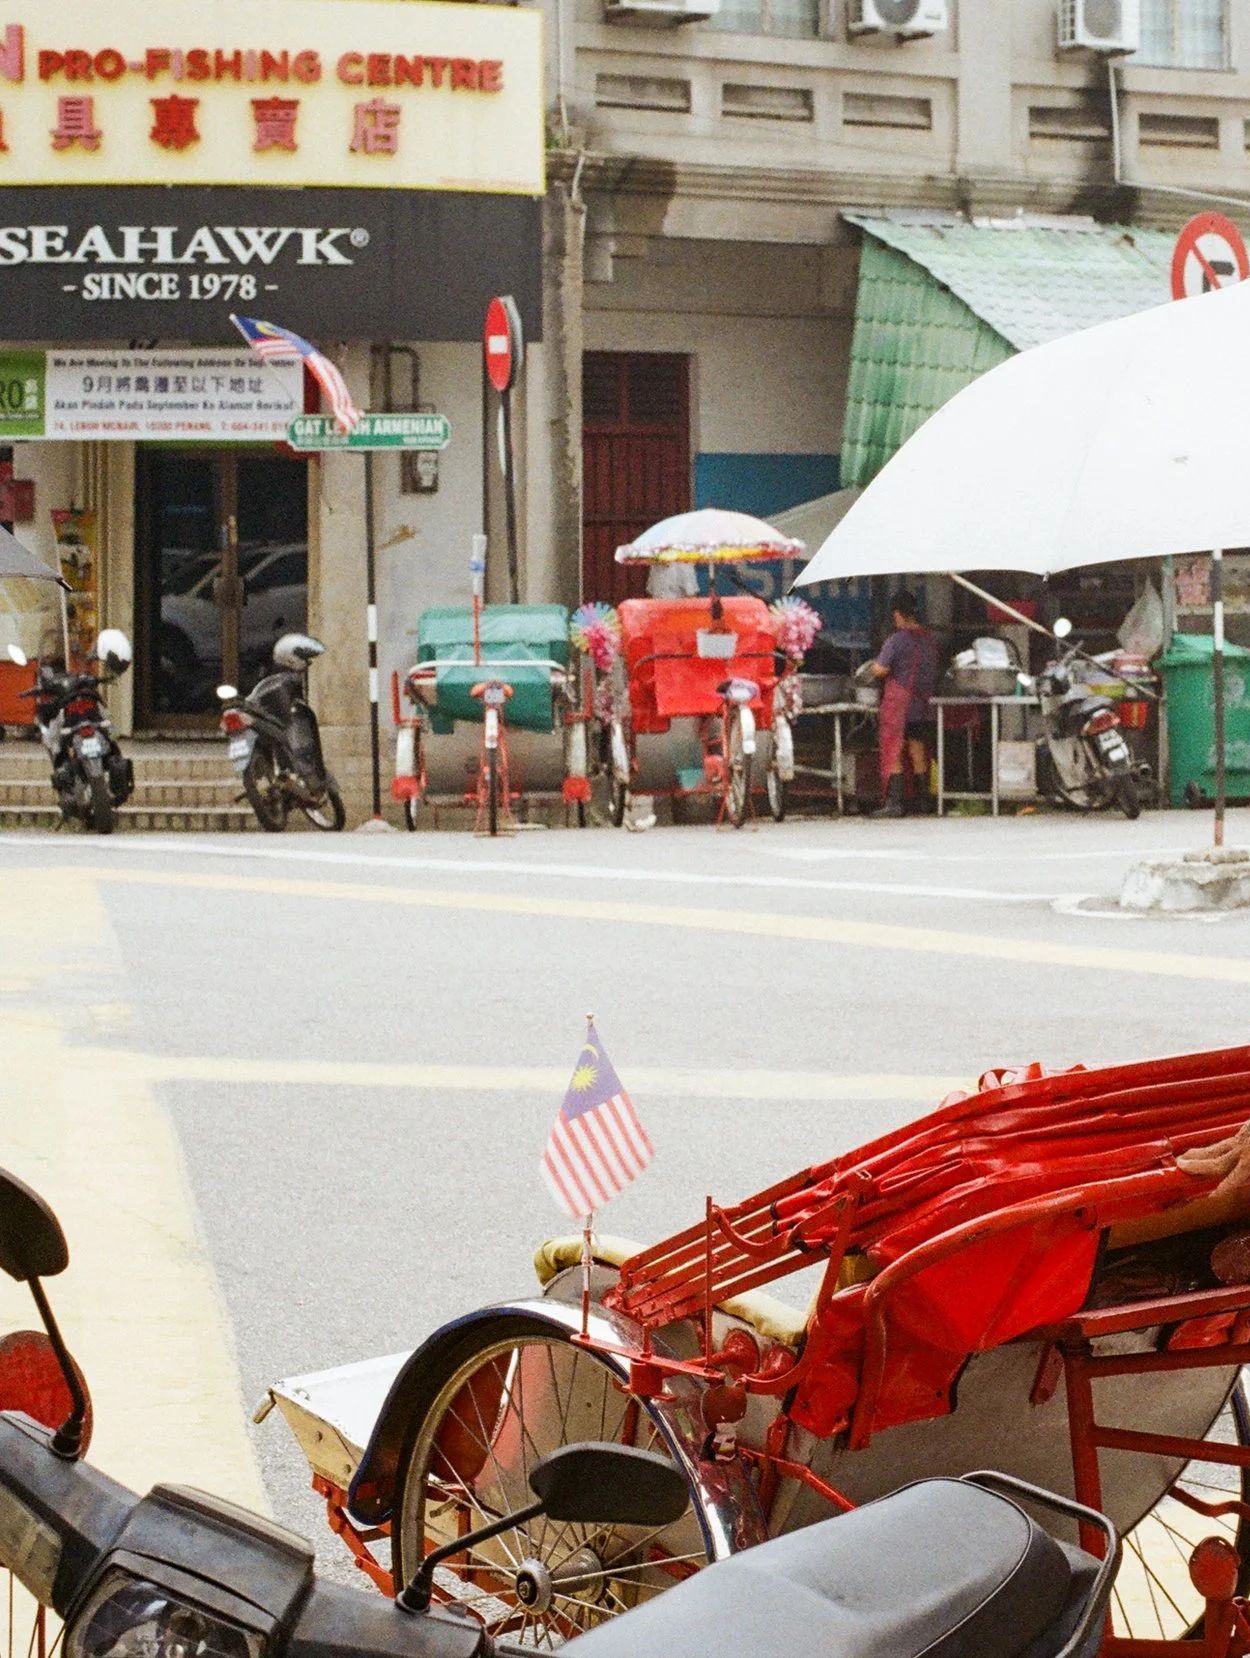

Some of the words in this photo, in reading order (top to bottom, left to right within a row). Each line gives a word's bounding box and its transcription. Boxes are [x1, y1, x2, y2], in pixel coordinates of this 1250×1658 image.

[38, 48, 321, 84] PRO-FISHING
[336, 51, 504, 93] CENTRE
[295, 419, 321, 435] GAT
[374, 418, 444, 435] ARMENIAN
